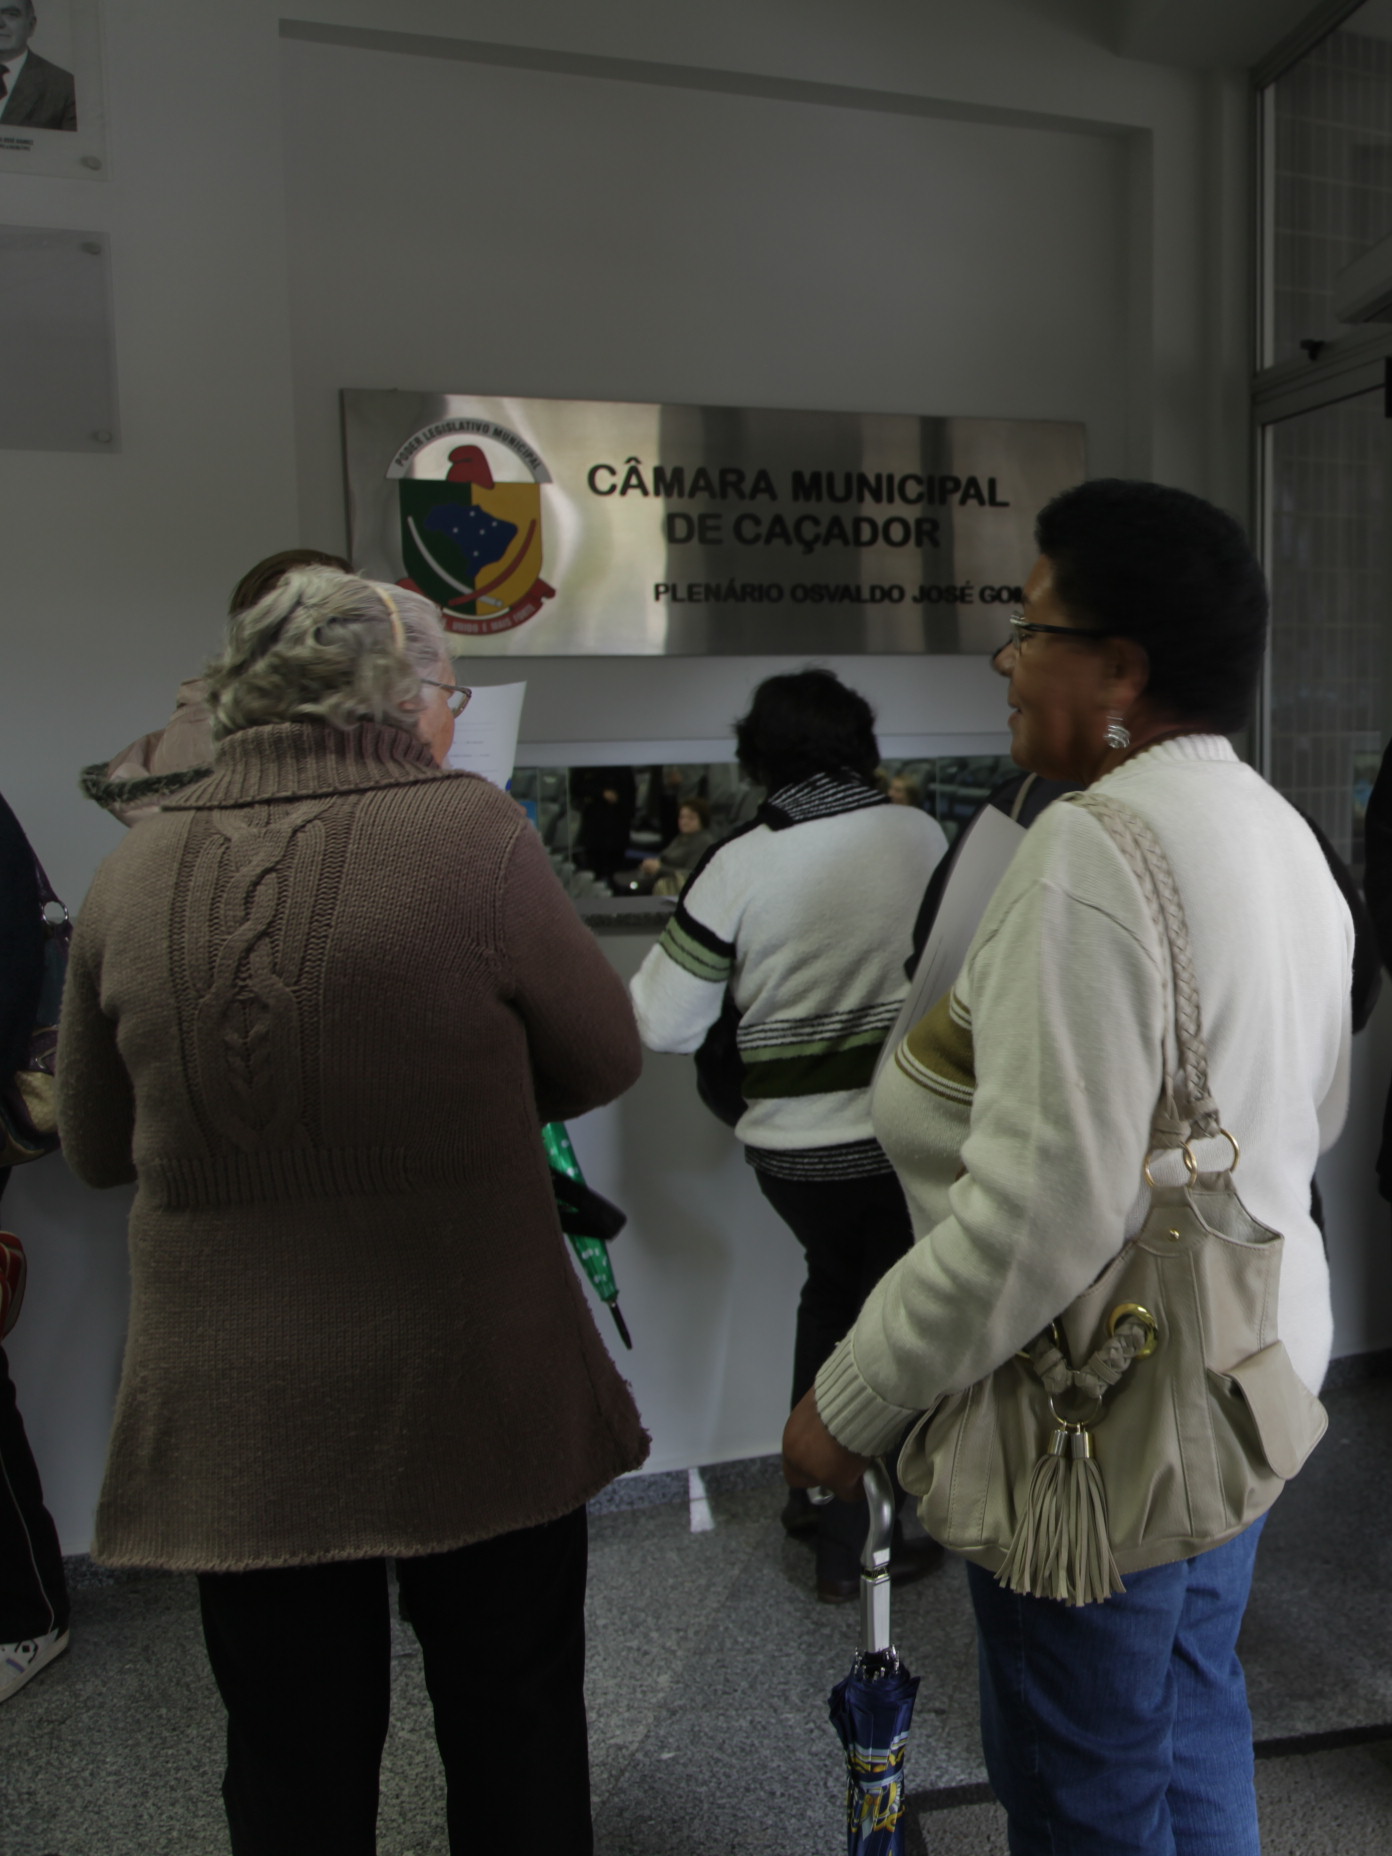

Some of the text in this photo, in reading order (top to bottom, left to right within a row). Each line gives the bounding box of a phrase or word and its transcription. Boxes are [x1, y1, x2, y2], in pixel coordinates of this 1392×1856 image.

[395, 421, 542, 471] PODER LEGISLATIVO MUNICIPAL
[587, 457, 1011, 508] CÂMARA MUNICIPAL
[666, 513, 940, 554] DE CAÇADOR
[654, 577, 781, 603] PLENÁRIO
[789, 583, 906, 604] OSVALDO
[912, 580, 974, 604] JOSÉ
